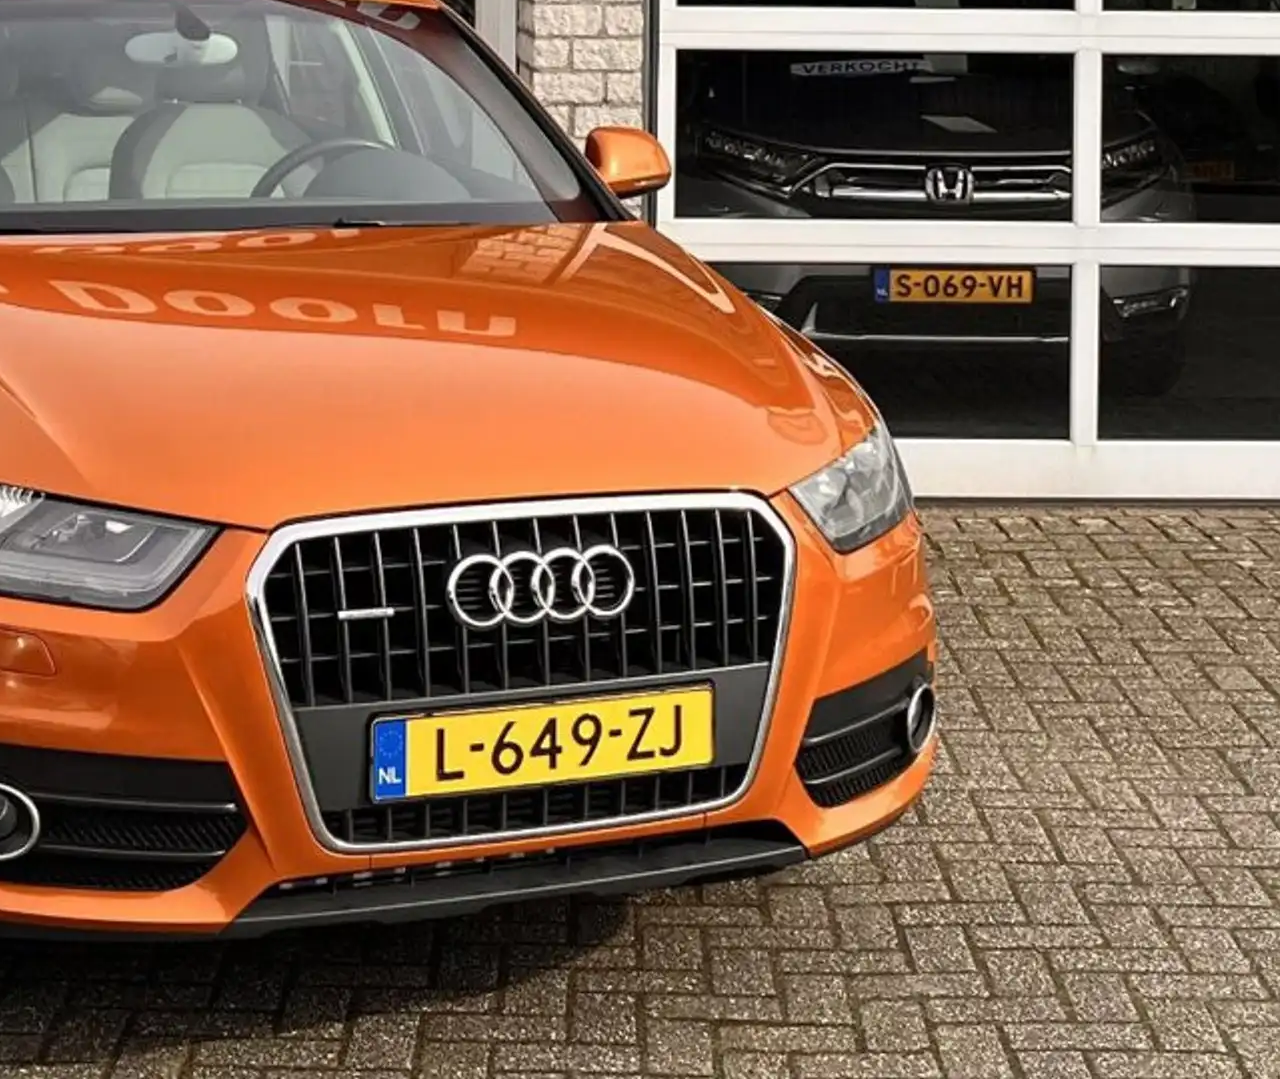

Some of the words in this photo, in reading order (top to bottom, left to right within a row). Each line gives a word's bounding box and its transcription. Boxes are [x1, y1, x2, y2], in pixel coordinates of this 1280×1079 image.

[896, 274, 1023, 298] S-069-VH
[378, 767, 402, 784] NL
[436, 705, 682, 781] L-649-ZJ
